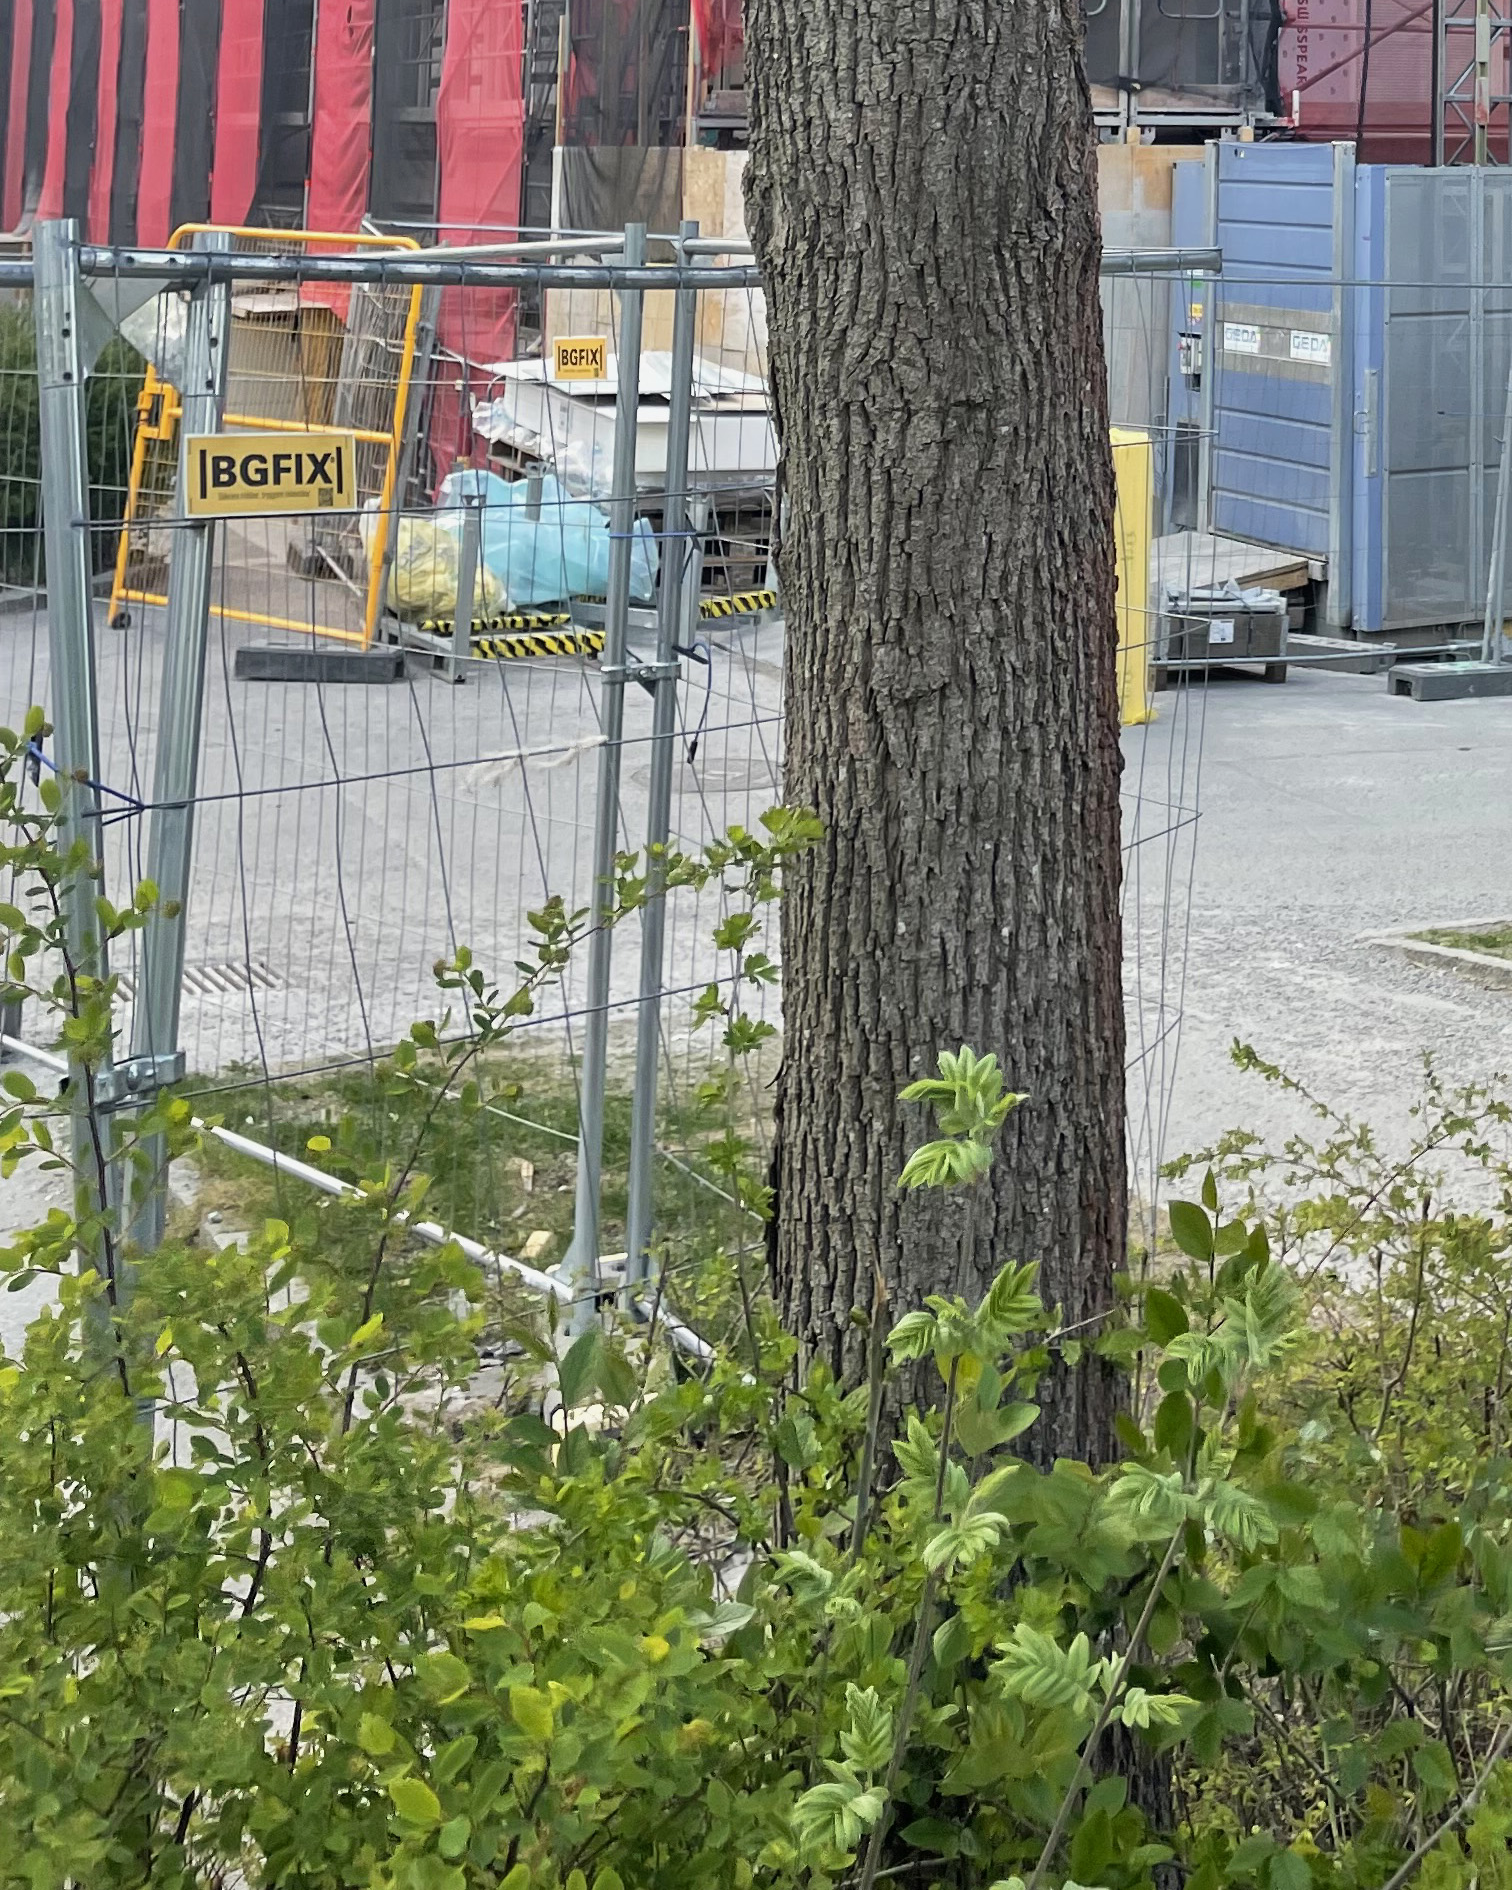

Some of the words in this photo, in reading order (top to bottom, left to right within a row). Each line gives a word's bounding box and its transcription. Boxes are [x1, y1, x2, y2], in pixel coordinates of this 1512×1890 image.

[1293, 335, 1328, 352] GEDA
[561, 348, 599, 366] BGFIX
[211, 453, 334, 488] BGFIX
